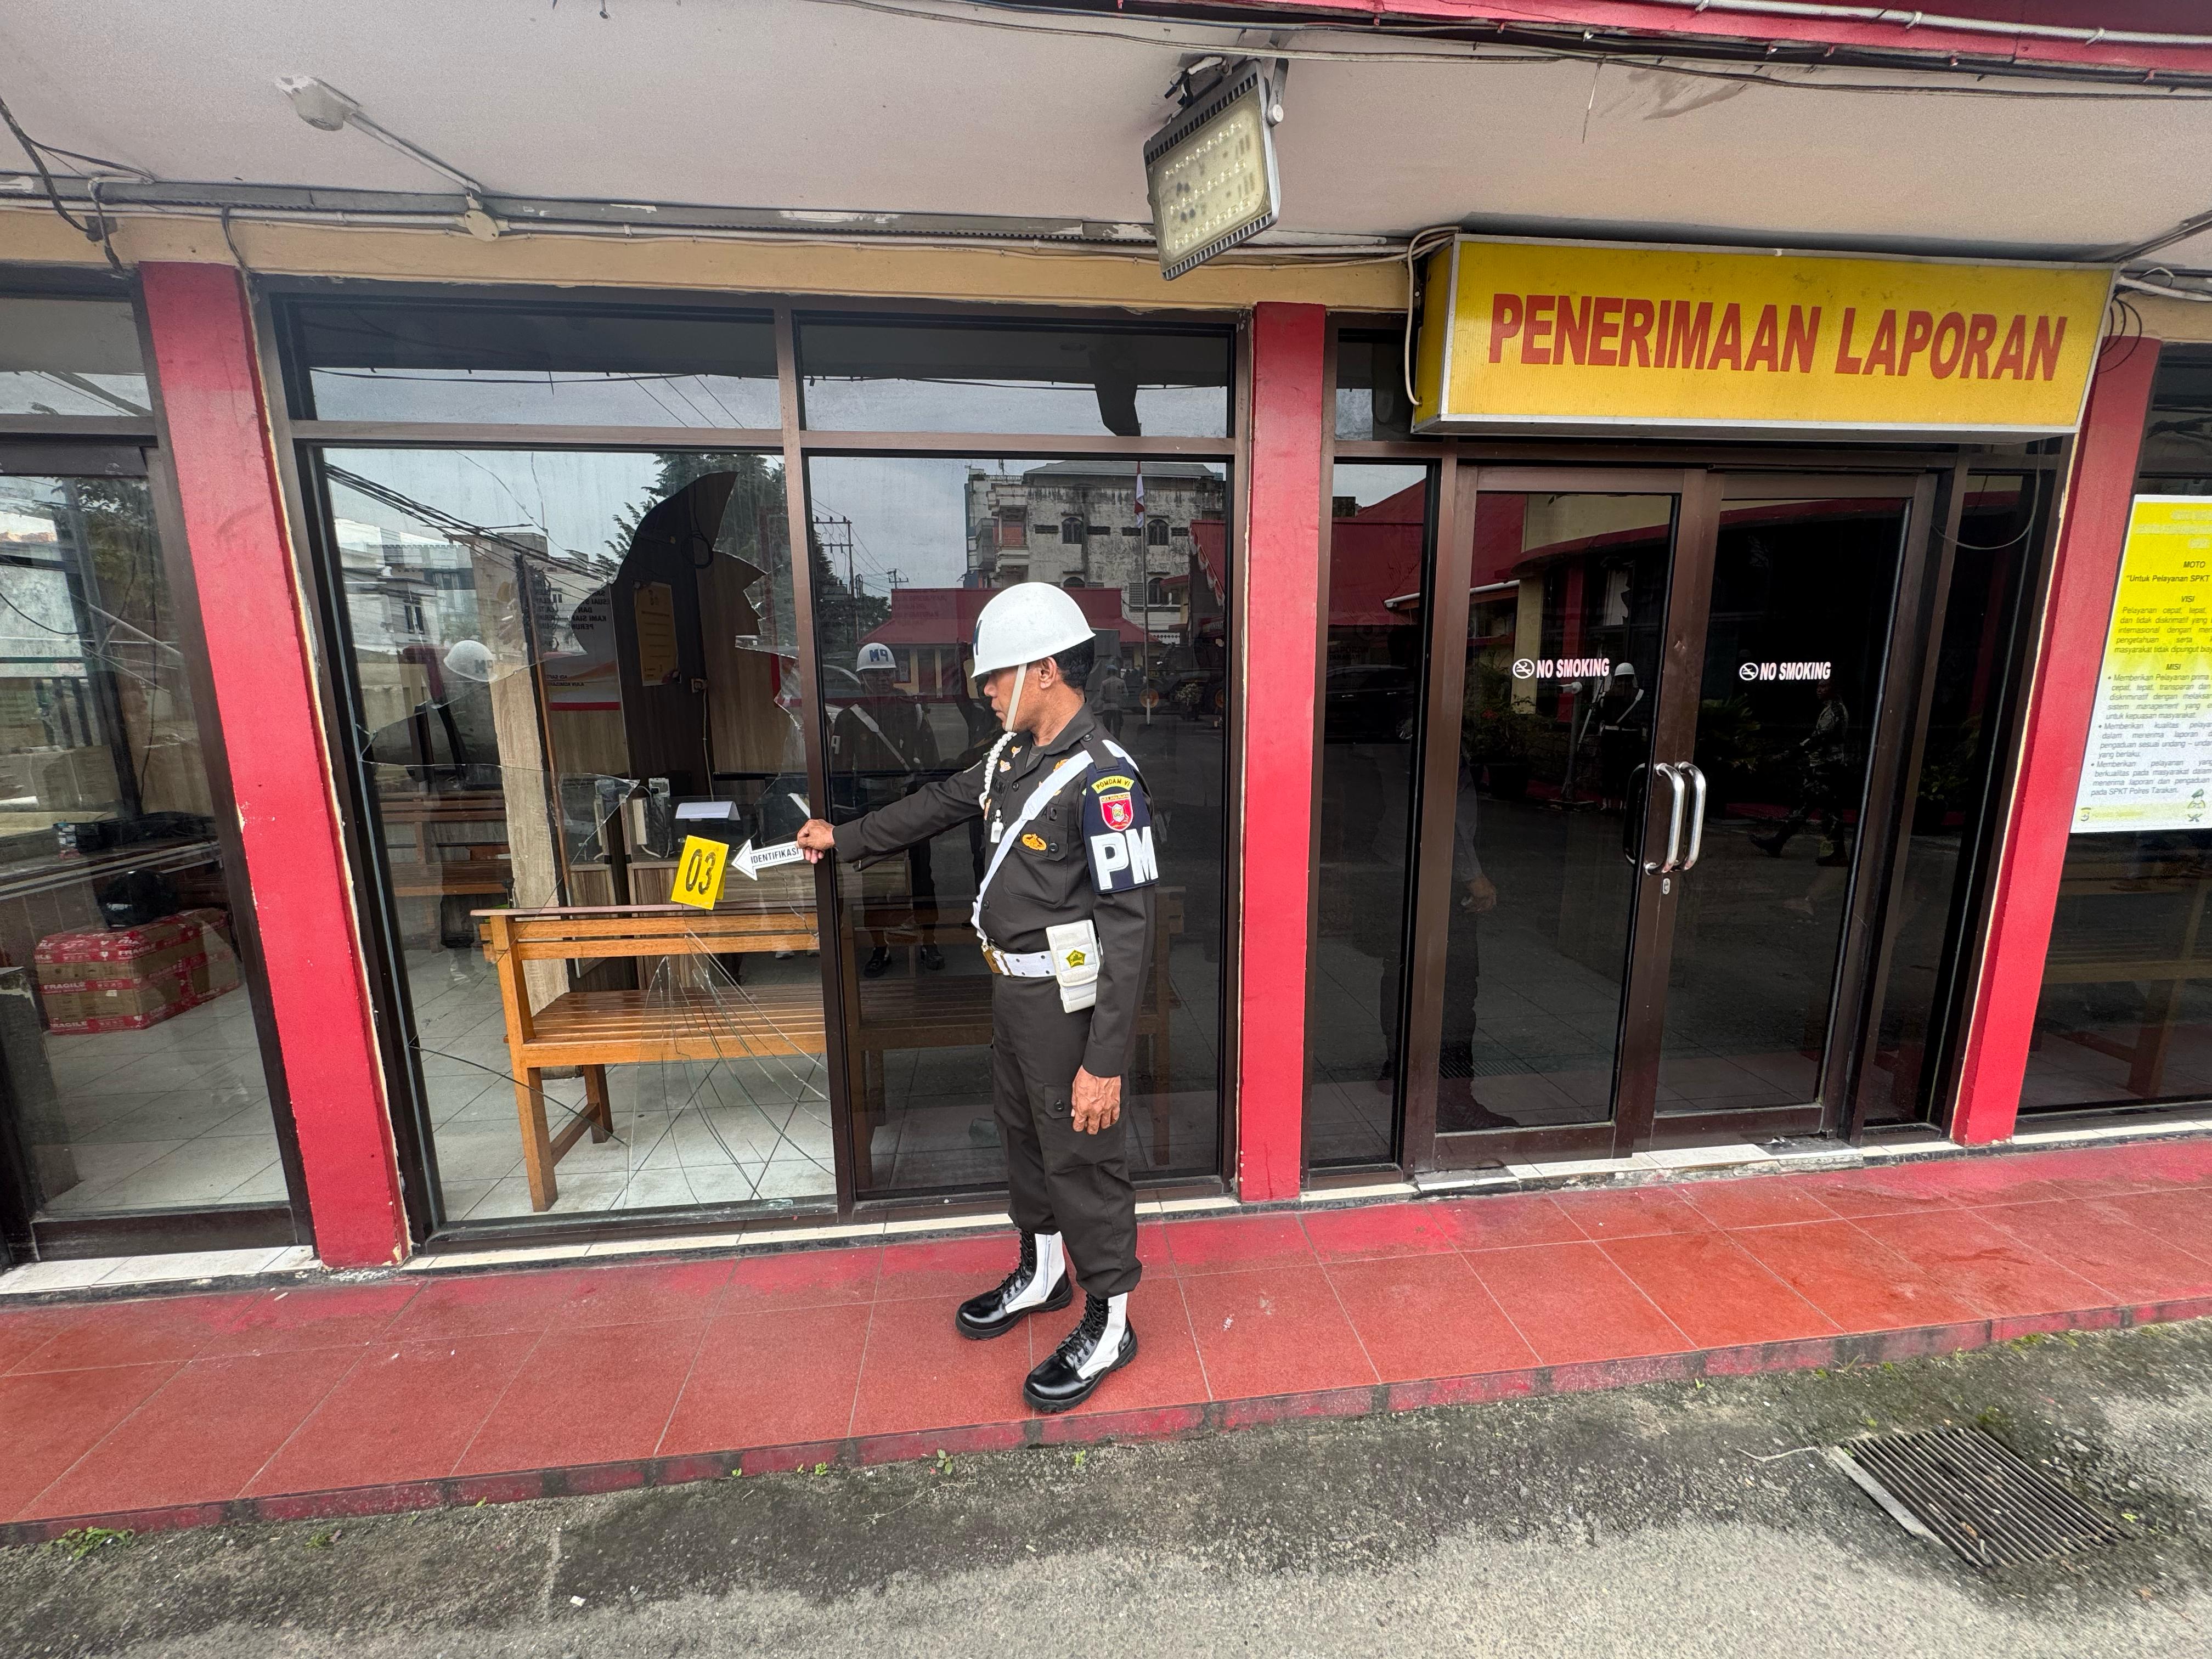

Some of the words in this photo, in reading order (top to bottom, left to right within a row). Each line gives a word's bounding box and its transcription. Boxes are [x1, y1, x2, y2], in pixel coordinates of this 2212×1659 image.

[1488, 293, 1821, 373] PENERIMAAN
[1835, 307, 2067, 381] LAPORAN
[2152, 575, 2188, 584] Pelayanan
[2123, 607, 2157, 615] Pelayanan
[2167, 627, 2192, 635] dengan
[2116, 636, 2159, 645] pengetahuan
[1536, 659, 1554, 678] NO
[1556, 658, 1610, 678] SMOKING
[1759, 663, 1777, 681] NO
[1778, 662, 1831, 681] SMOKING
[2155, 674, 2190, 682] Pelayanan
[2136, 703, 2179, 711] management
[2100, 741, 2136, 750] pengaduan
[2094, 769, 2129, 777] berkualitas
[2152, 769, 2189, 777] masyarakat
[1096, 778, 1122, 790] POMDAM
[2129, 778, 2154, 786] laporan
[2175, 777, 2210, 786] pengaduan
[2091, 788, 2107, 797] pada
[2109, 787, 2128, 795] SPKT
[751, 848, 799, 864] IDENTIFIKASI
[1090, 826, 1159, 890] PM
[686, 848, 716, 895] 03
